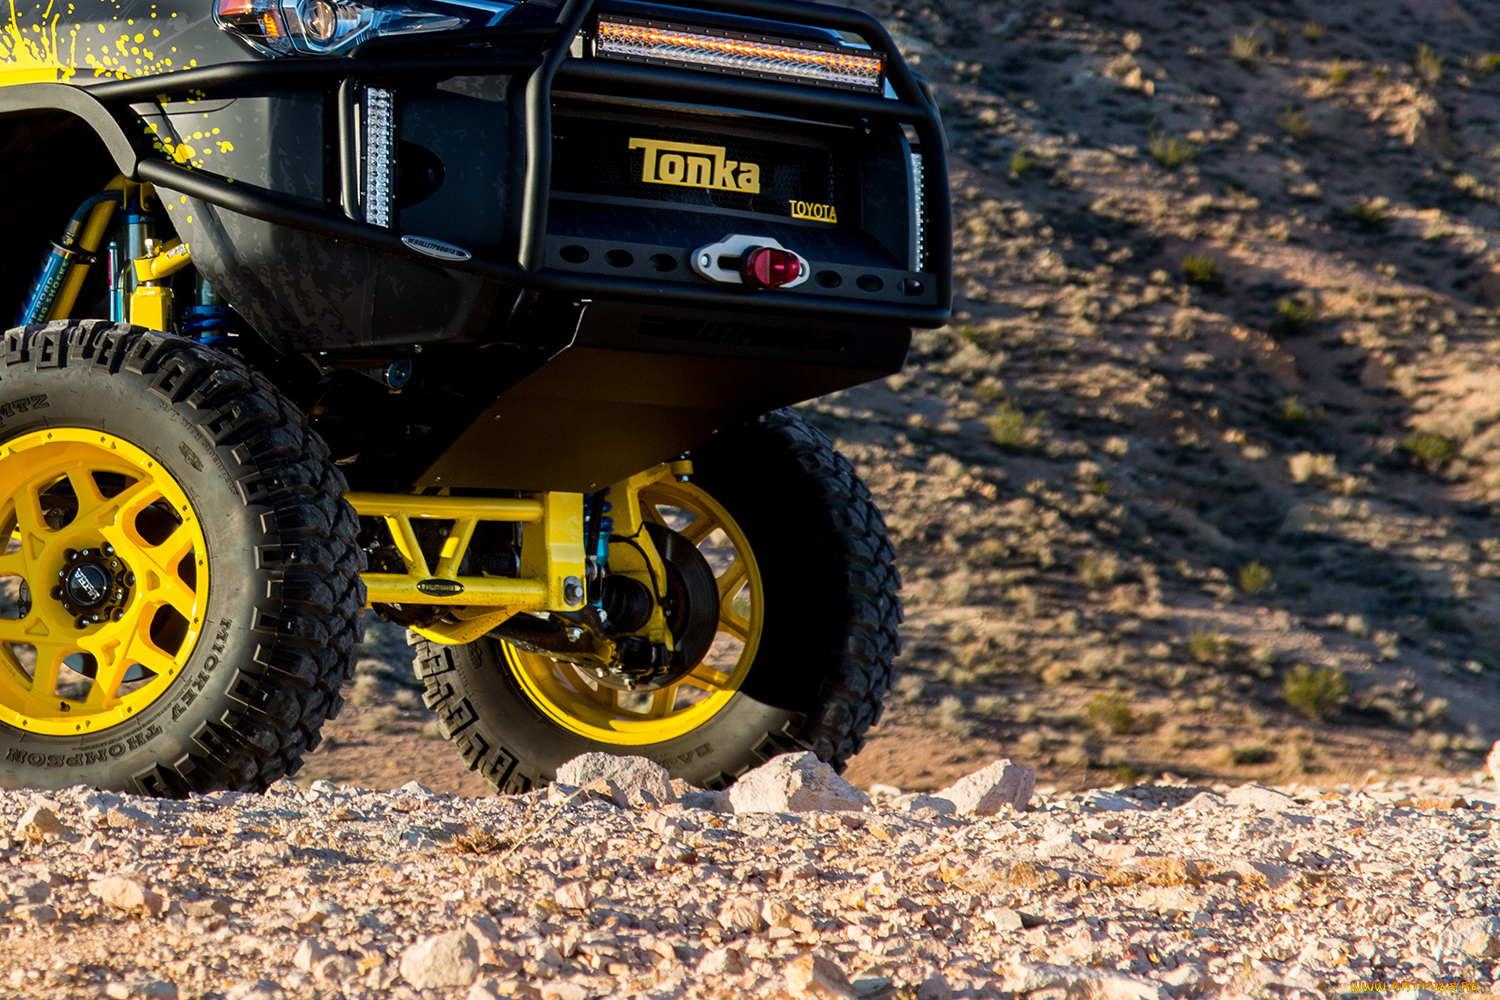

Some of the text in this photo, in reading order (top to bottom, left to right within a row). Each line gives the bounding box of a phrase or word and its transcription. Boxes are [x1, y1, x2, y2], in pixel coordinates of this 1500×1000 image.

[629, 137, 760, 194] Tonka
[789, 199, 838, 224] TOYOTA
[46, 262, 68, 304] SHOCKS
[170, 617, 232, 722] MICKEY
[5, 722, 163, 768] THOMPSON
